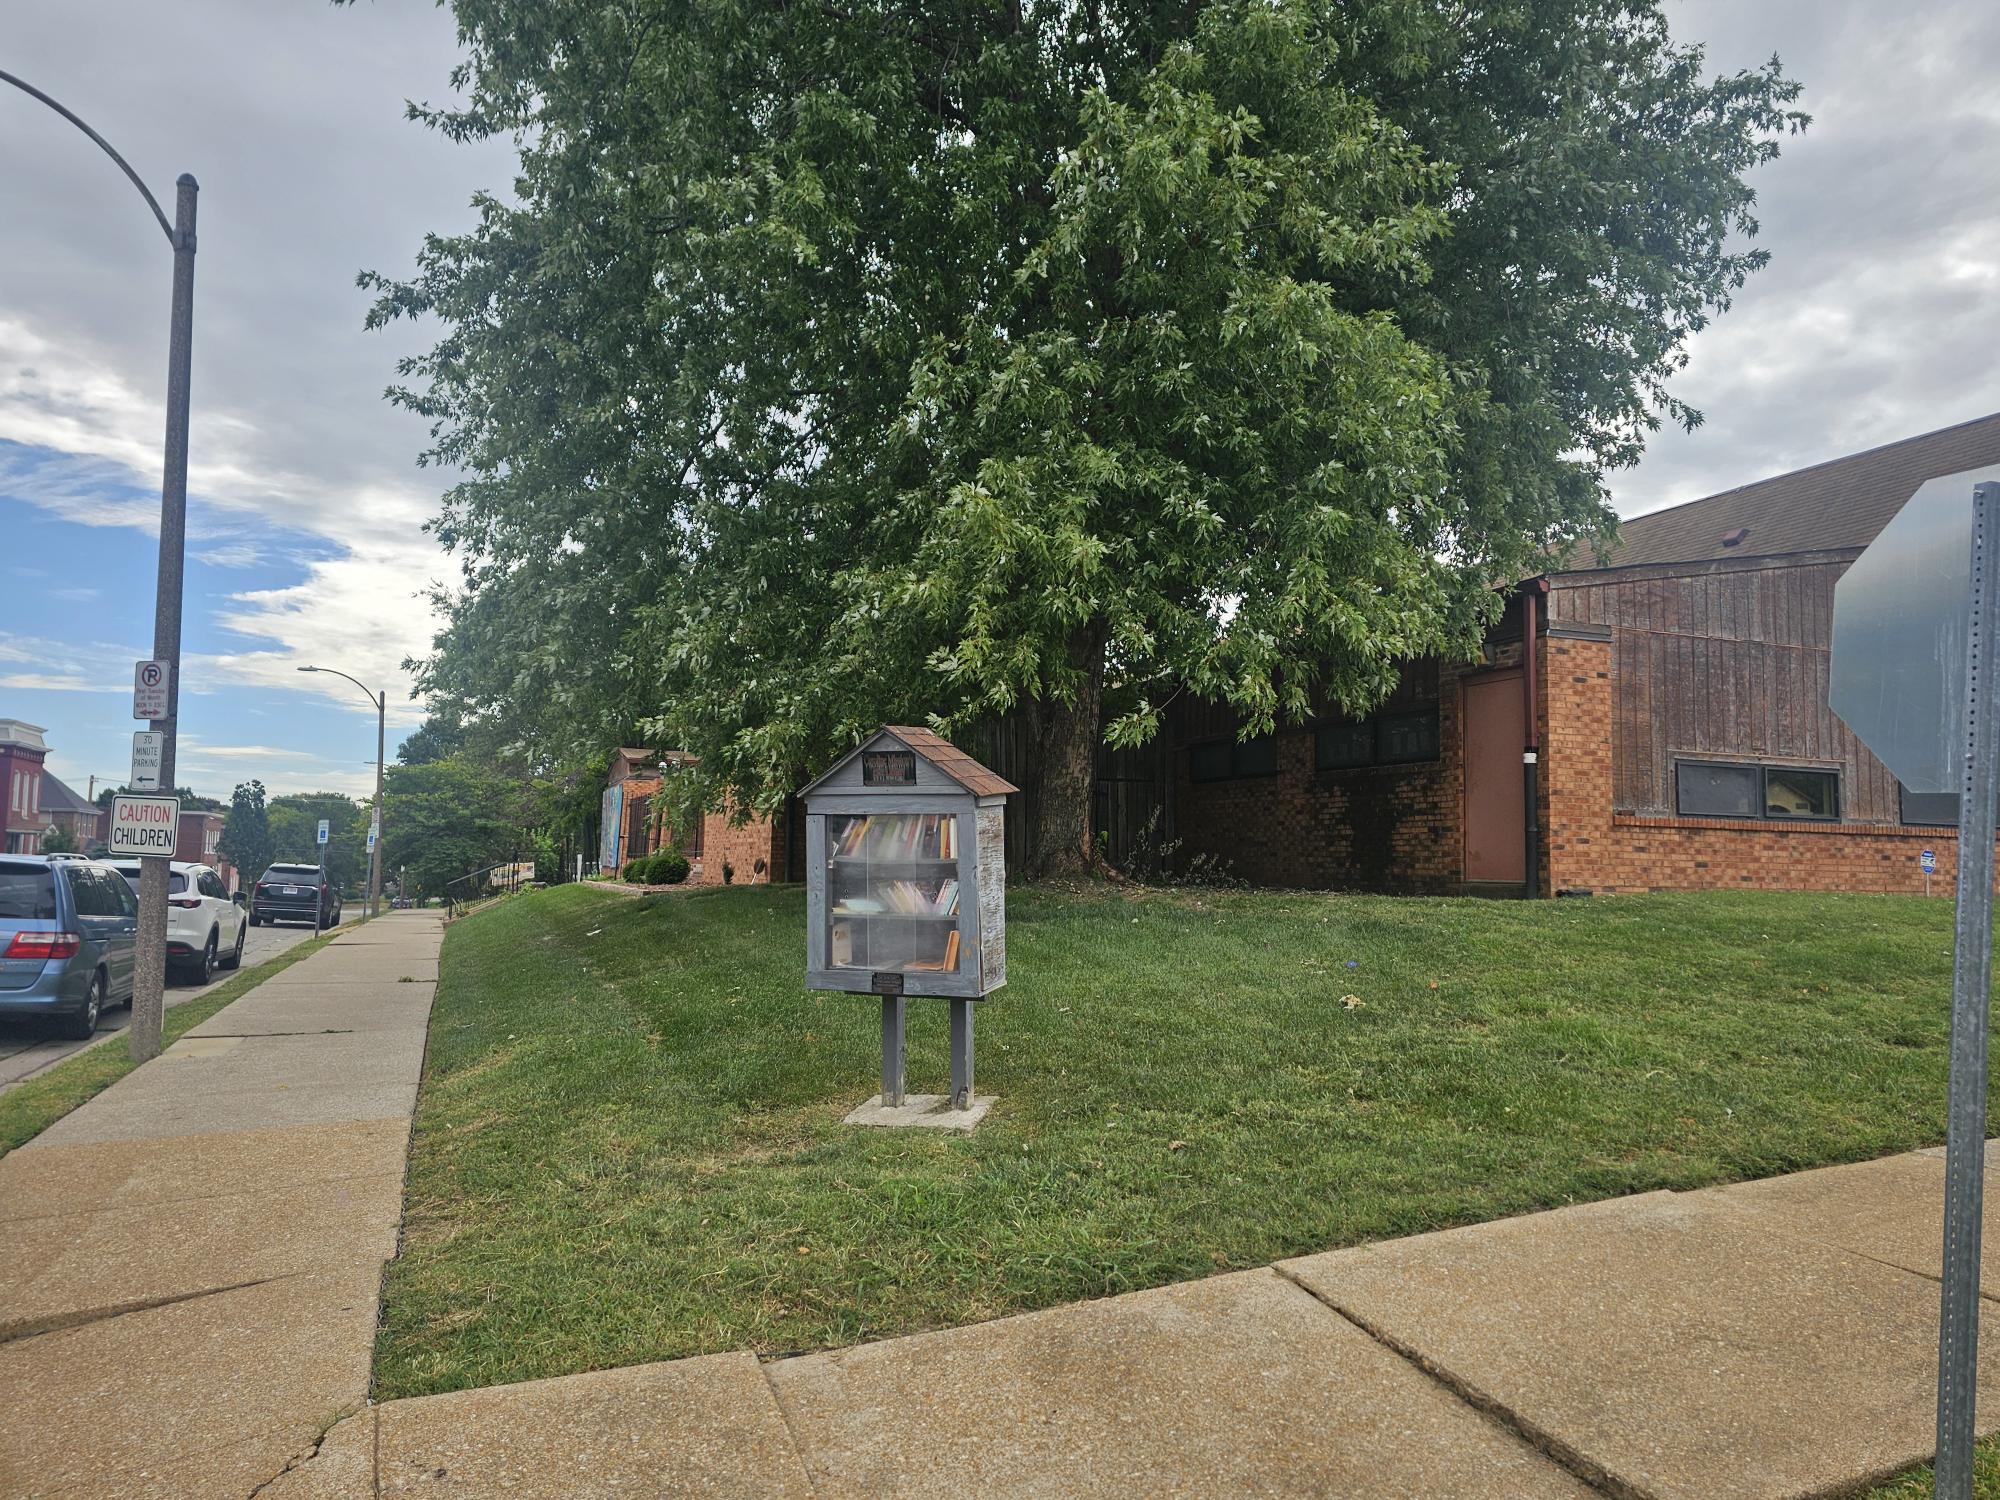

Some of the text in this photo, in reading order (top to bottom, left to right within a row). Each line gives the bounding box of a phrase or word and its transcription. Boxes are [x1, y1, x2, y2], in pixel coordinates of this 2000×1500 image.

[144, 735, 153, 745] 30
[136, 747, 159, 756] MINUTE
[133, 758, 159, 768] PARKING
[120, 804, 171, 823] CAUTION
[114, 827, 173, 847] CHILDREN
